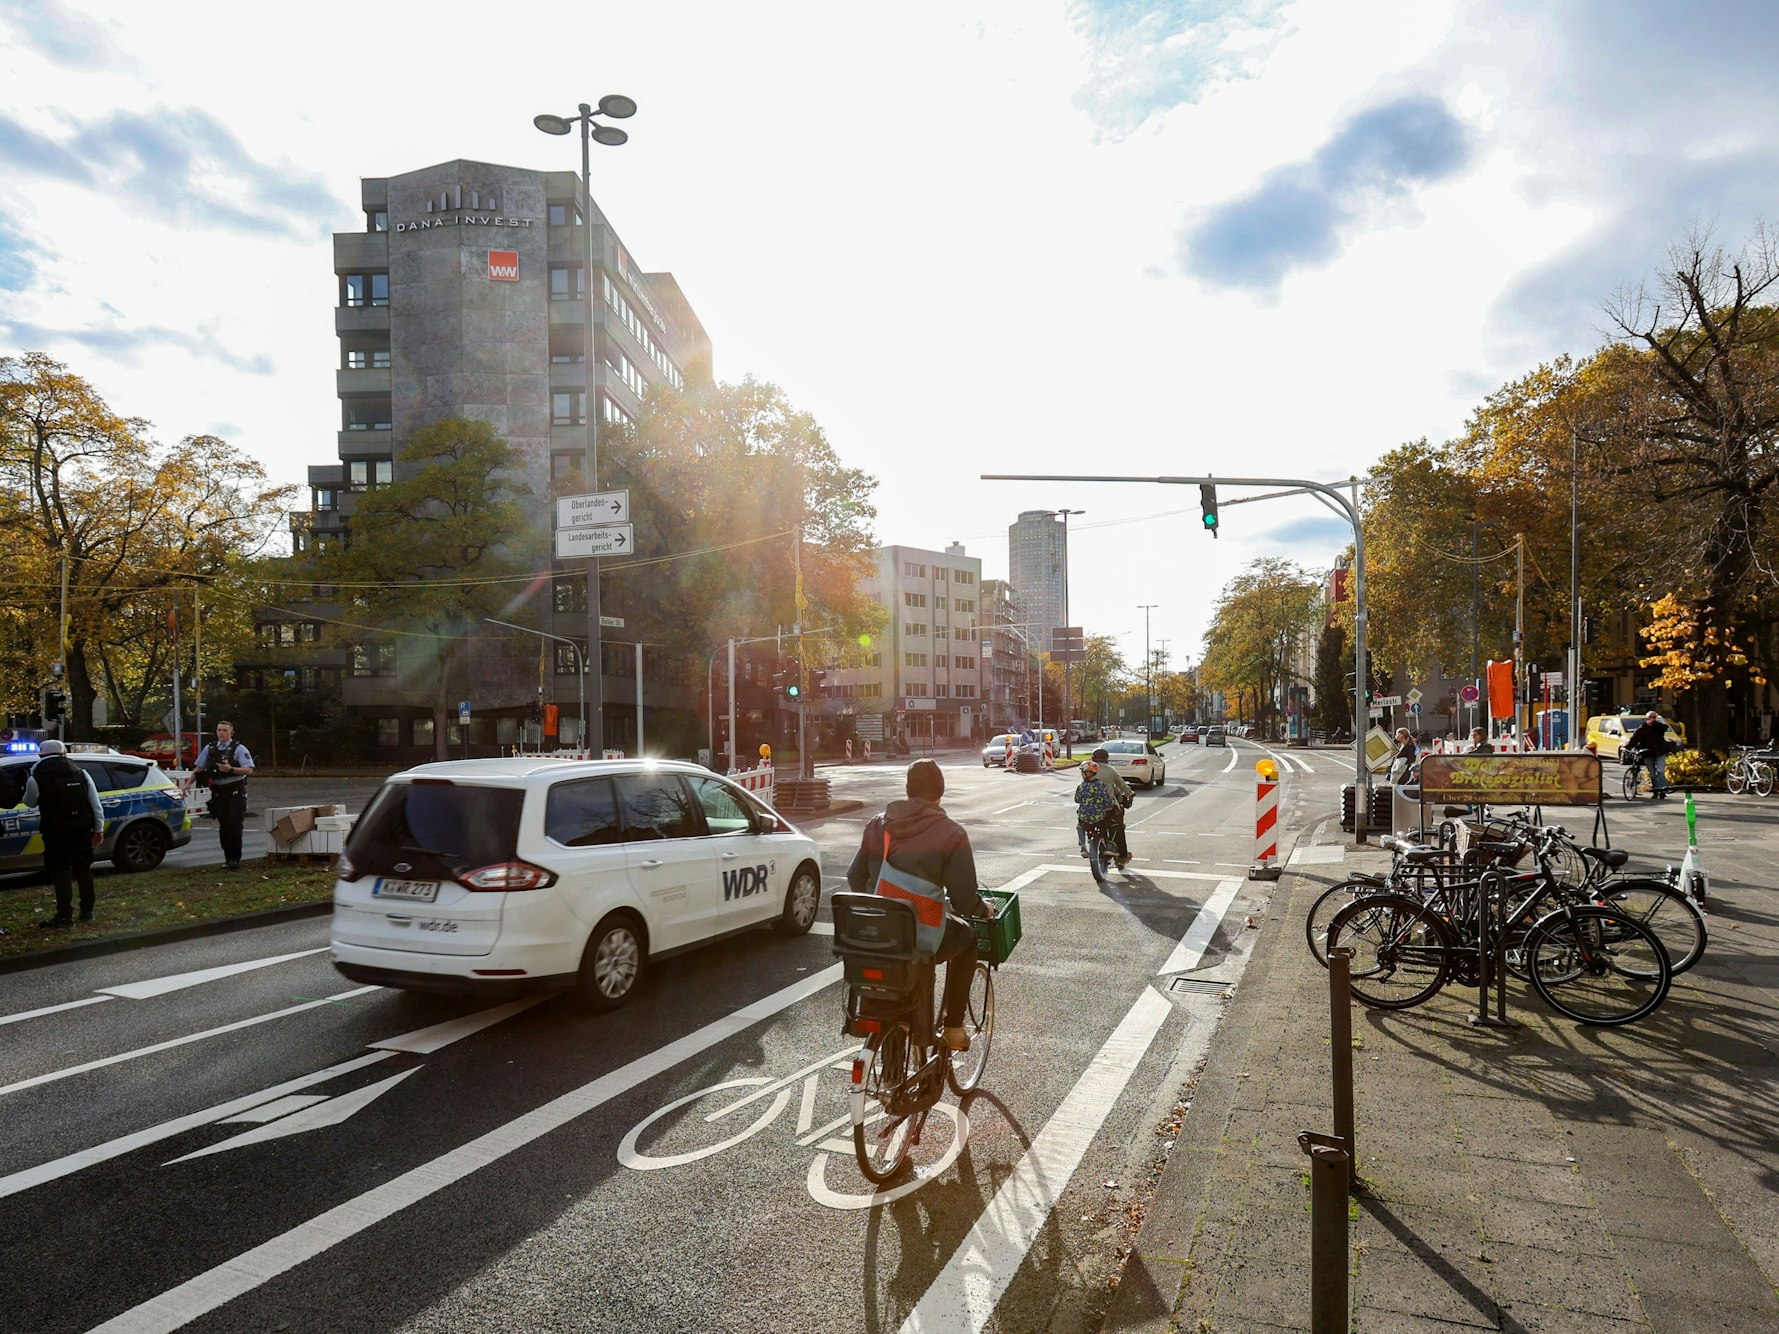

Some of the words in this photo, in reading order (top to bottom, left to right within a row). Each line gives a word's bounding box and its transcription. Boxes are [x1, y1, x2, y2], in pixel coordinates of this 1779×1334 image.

[397, 218, 443, 232] DANA
[455, 215, 533, 228] INVEST
[571, 499, 608, 510] Oberlandes-
[571, 512, 593, 524] gericht
[568, 531, 612, 542] Landesarbeits-
[591, 543, 613, 554] gericht
[1449, 771, 1561, 788] Brotspezialist
[722, 864, 768, 901] WDR
[411, 883, 433, 896] 273
[419, 919, 459, 932] wdr.de
